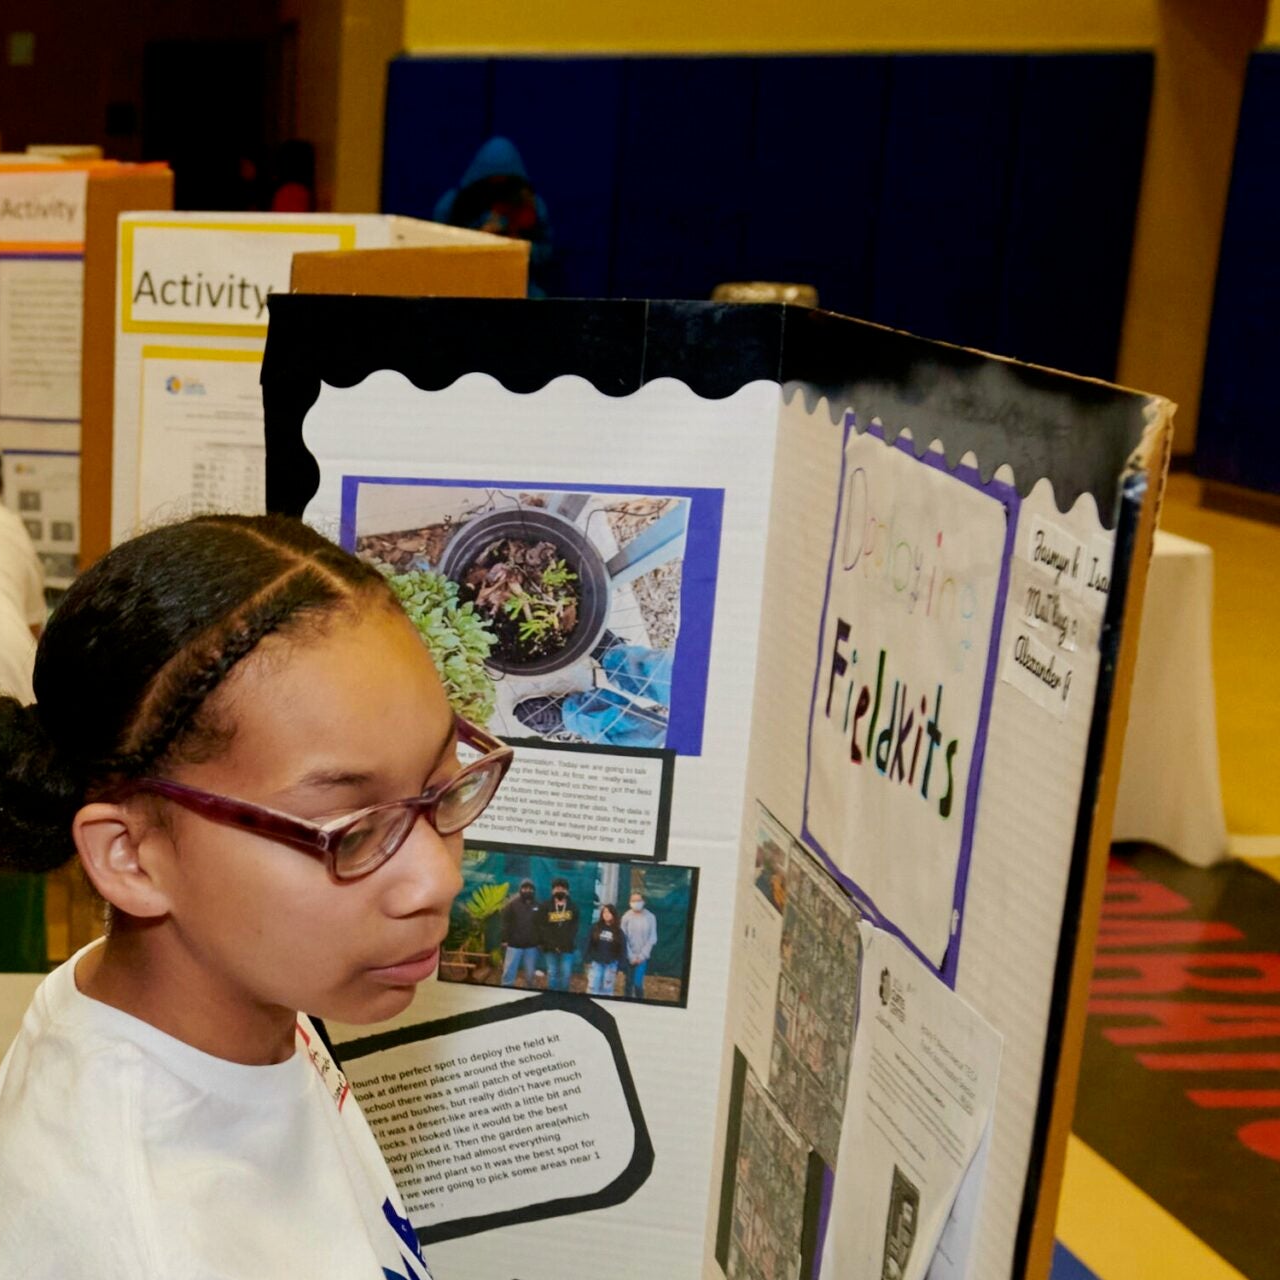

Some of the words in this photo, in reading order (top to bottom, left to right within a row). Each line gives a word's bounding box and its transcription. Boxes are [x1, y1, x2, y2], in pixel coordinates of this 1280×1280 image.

[0, 197, 78, 223] Activity
[132, 270, 273, 320] Activity
[825, 617, 958, 819] Fieldkits
[351, 1076, 379, 1088] found
[380, 1073, 396, 1082] the
[398, 1064, 431, 1080] perfect
[433, 1059, 455, 1071] spot
[469, 1049, 502, 1062] deploy
[504, 1044, 521, 1053] the
[522, 1037, 545, 1048] field
[546, 1034, 559, 1043] kit
[377, 1088, 386, 1097] at
[387, 1079, 427, 1094] different
[429, 1072, 460, 1087] places
[463, 1062, 497, 1077] around
[499, 1059, 515, 1068] the
[518, 1049, 554, 1064] school.
[363, 1099, 395, 1114] school
[396, 1095, 421, 1106] there
[423, 1091, 443, 1100] was
[453, 1081, 479, 1093] small
[481, 1074, 509, 1088] patch
[511, 1070, 521, 1080] of
[523, 1059, 575, 1077] vegetation
[367, 1116, 389, 1125] rees
[390, 1110, 408, 1121] and
[409, 1104, 447, 1118] bushes,
[449, 1098, 466, 1108] but
[468, 1092, 494, 1103] really
[526, 1079, 550, 1089] have
[553, 1071, 581, 1084] much
[378, 1129, 385, 1137] it
[386, 1126, 406, 1135] was
[415, 1113, 465, 1130] desert-like
[468, 1107, 489, 1118] area
[490, 1101, 512, 1112] with
[522, 1095, 544, 1105] little
[546, 1090, 559, 1100] bit
[562, 1085, 581, 1096] and
[409, 1136, 417, 1144] It
[418, 1128, 450, 1142] looked
[452, 1125, 470, 1134] like
[472, 1122, 479, 1130] it
[481, 1115, 511, 1128] would
[512, 1113, 525, 1121] be
[527, 1109, 543, 1118] the
[545, 1103, 567, 1114] best
[390, 1164, 413, 1175] ked)
[414, 1162, 425, 1170] in
[426, 1157, 451, 1168] there
[452, 1151, 471, 1162] had
[474, 1144, 506, 1157] almost
[508, 1133, 560, 1150] everything
[409, 1145, 441, 1160] picked
[454, 1137, 478, 1147] Then
[480, 1133, 496, 1142] the
[498, 1125, 532, 1140] garden
[423, 1171, 442, 1182] and
[443, 1166, 467, 1179] plant
[469, 1164, 482, 1172] so
[492, 1157, 512, 1167] was
[514, 1154, 530, 1162] the
[532, 1147, 554, 1159] best
[556, 1142, 578, 1154] spot
[580, 1139, 594, 1148] for
[405, 1191, 419, 1199] we
[421, 1185, 444, 1195] were
[446, 1179, 474, 1192] going
[488, 1171, 509, 1183] pick
[511, 1166, 537, 1176] some
[540, 1159, 567, 1170] areas
[569, 1154, 590, 1164] near
[594, 1151, 600, 1159] 1
